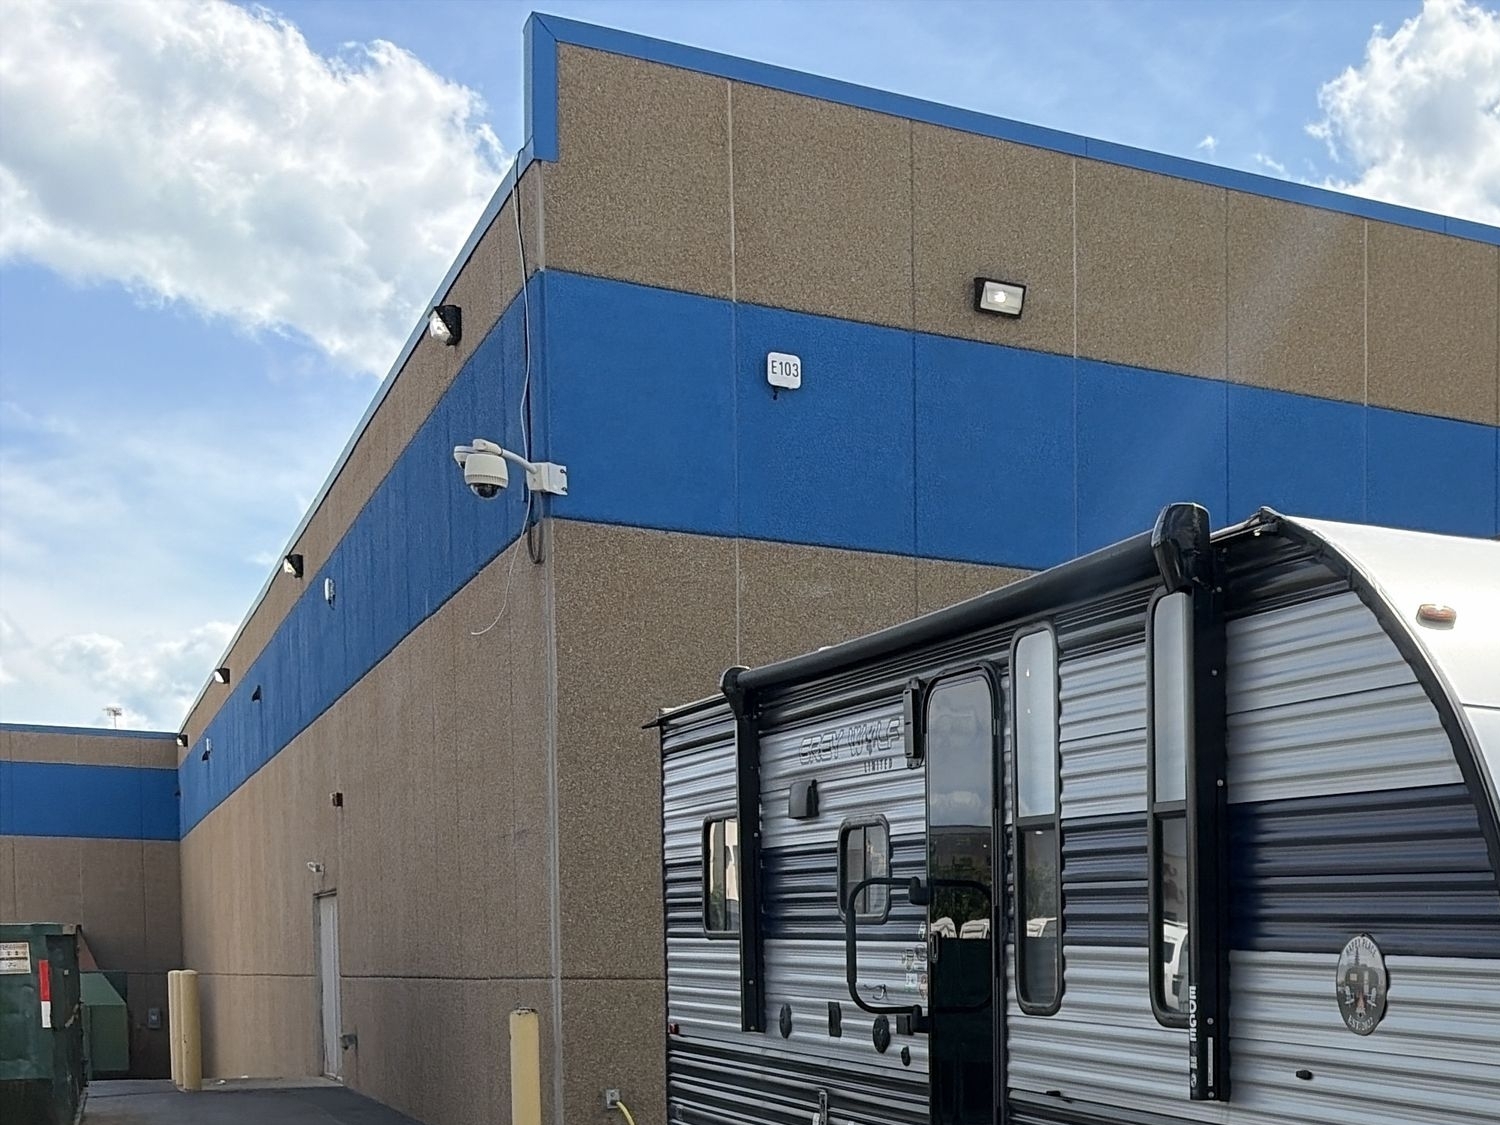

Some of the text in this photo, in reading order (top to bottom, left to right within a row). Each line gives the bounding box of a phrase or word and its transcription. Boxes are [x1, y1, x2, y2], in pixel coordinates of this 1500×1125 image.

[771, 360, 799, 378] E103
[800, 728, 844, 766] GREY
[863, 757, 893, 774] LIMITED
[1189, 985, 1198, 1042] EDGE
